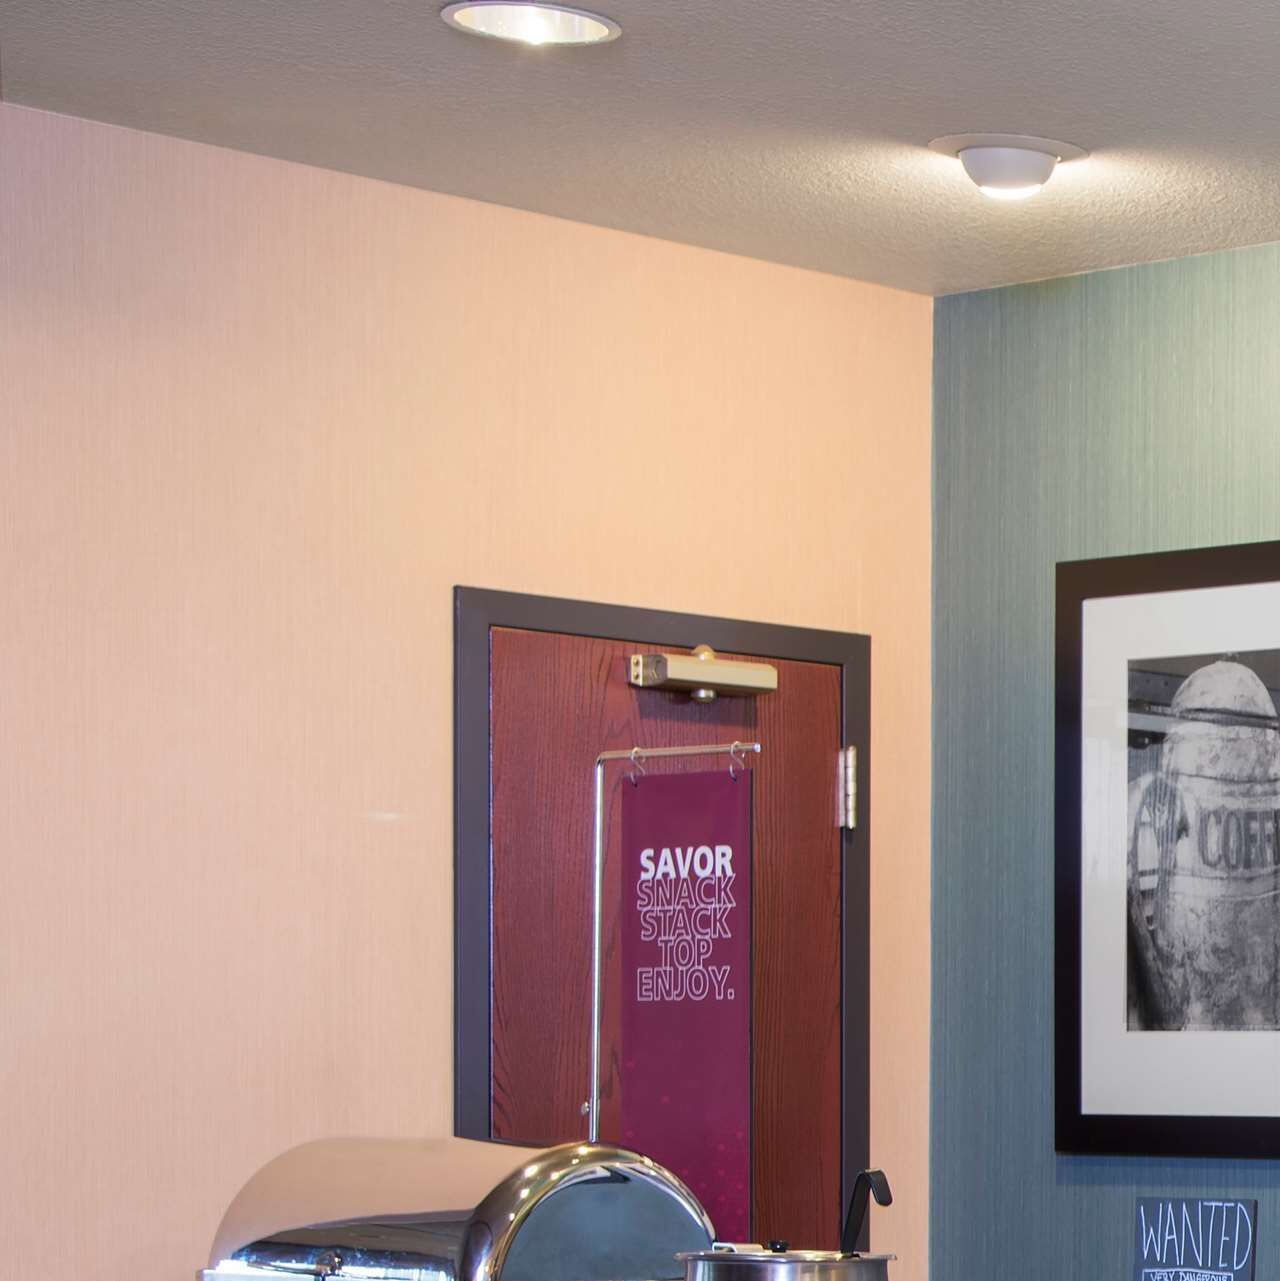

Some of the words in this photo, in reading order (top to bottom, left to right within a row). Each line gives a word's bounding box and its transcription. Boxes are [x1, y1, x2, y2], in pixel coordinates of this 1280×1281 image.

[639, 845, 734, 880] SAVOR
[637, 873, 736, 911] SNACK
[640, 906, 731, 941] STACK
[658, 937, 713, 970] TOP
[637, 965, 735, 1002] ENJOY.
[1140, 1200, 1252, 1270] WANTED
